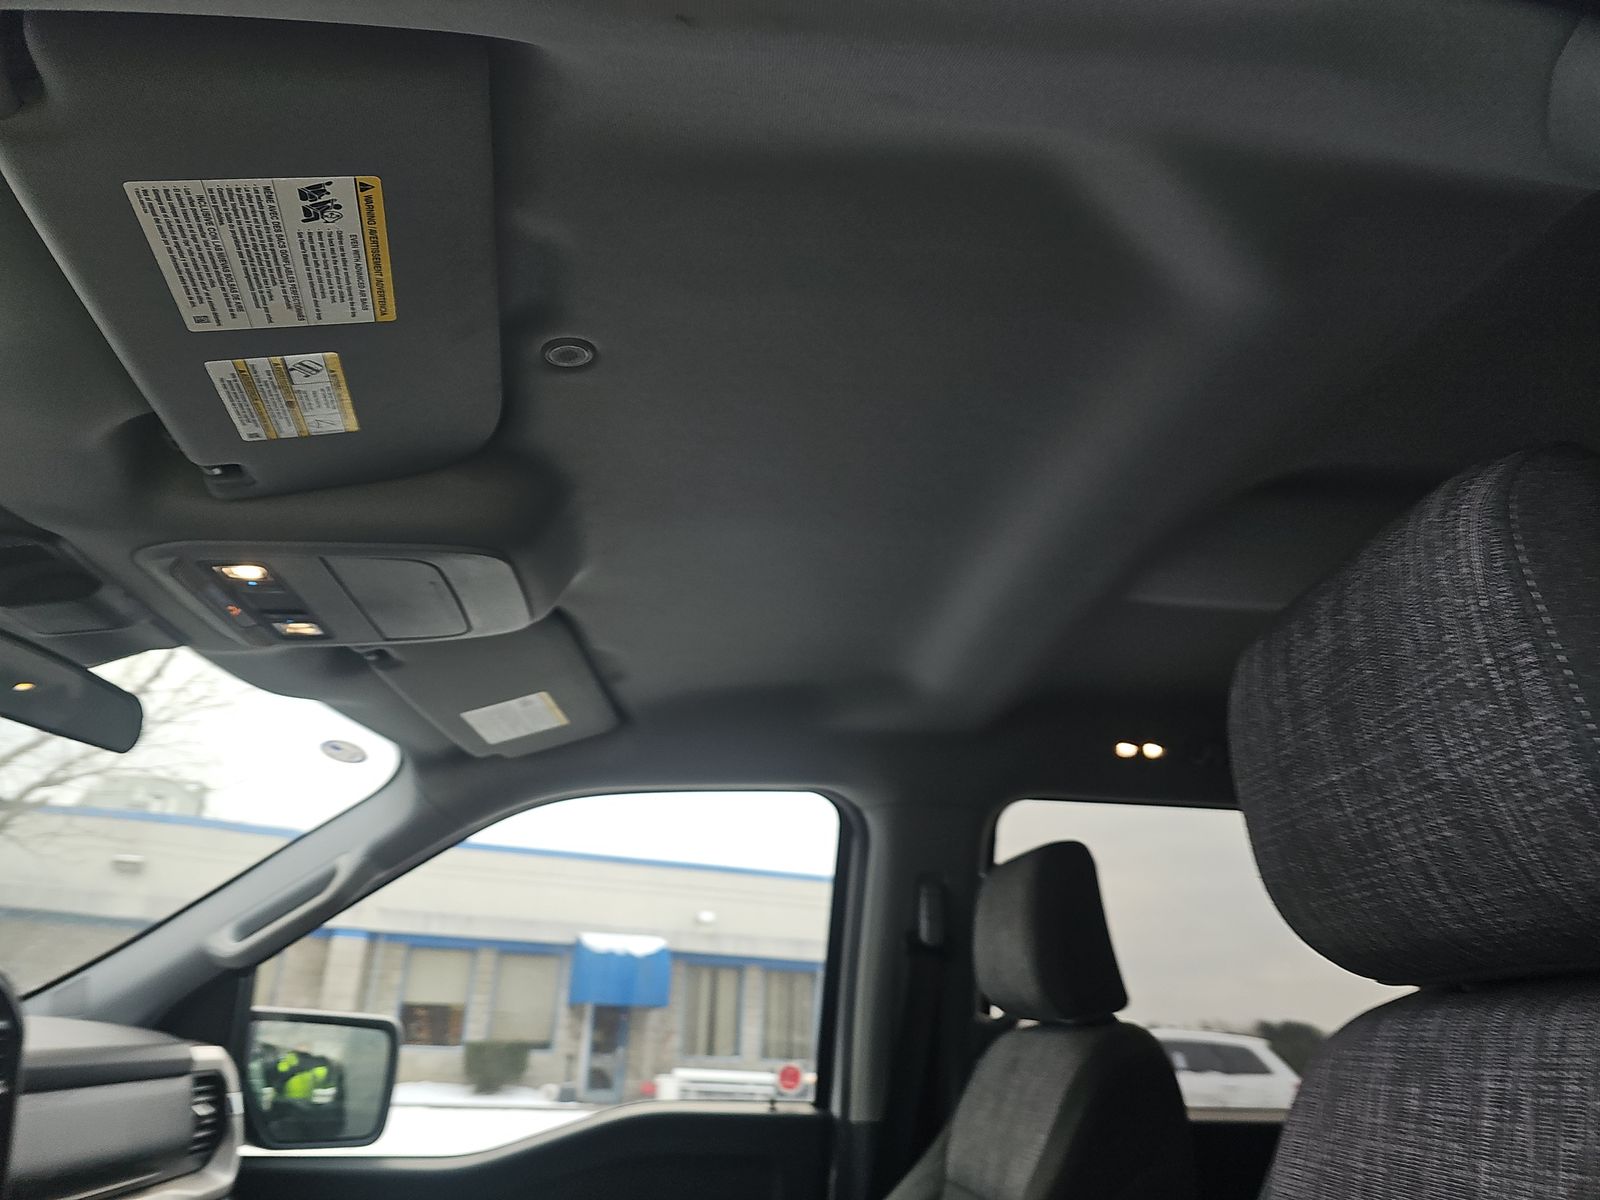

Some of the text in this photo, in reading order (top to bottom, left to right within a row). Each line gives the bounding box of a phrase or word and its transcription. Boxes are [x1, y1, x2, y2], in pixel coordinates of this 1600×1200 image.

[262, 185, 275, 203] MÊME
[195, 195, 214, 226] INCLUSIVE
[267, 204, 280, 220] AVEC
[363, 194, 376, 225] WARNING
[206, 227, 219, 240] CON
[271, 221, 283, 232] DES
[211, 241, 222, 251] LAS
[275, 233, 287, 248] SACS
[215, 252, 230, 272] NUEVAS
[367, 228, 382, 276] AVERTISSEMENT
[279, 249, 296, 283] GONFLABLES
[349, 234, 369, 310] EVEN WITH ADVANCED AIR BAGS
[223, 273, 237, 293] BOLSAS
[375, 279, 387, 316] ADVERTENCIA
